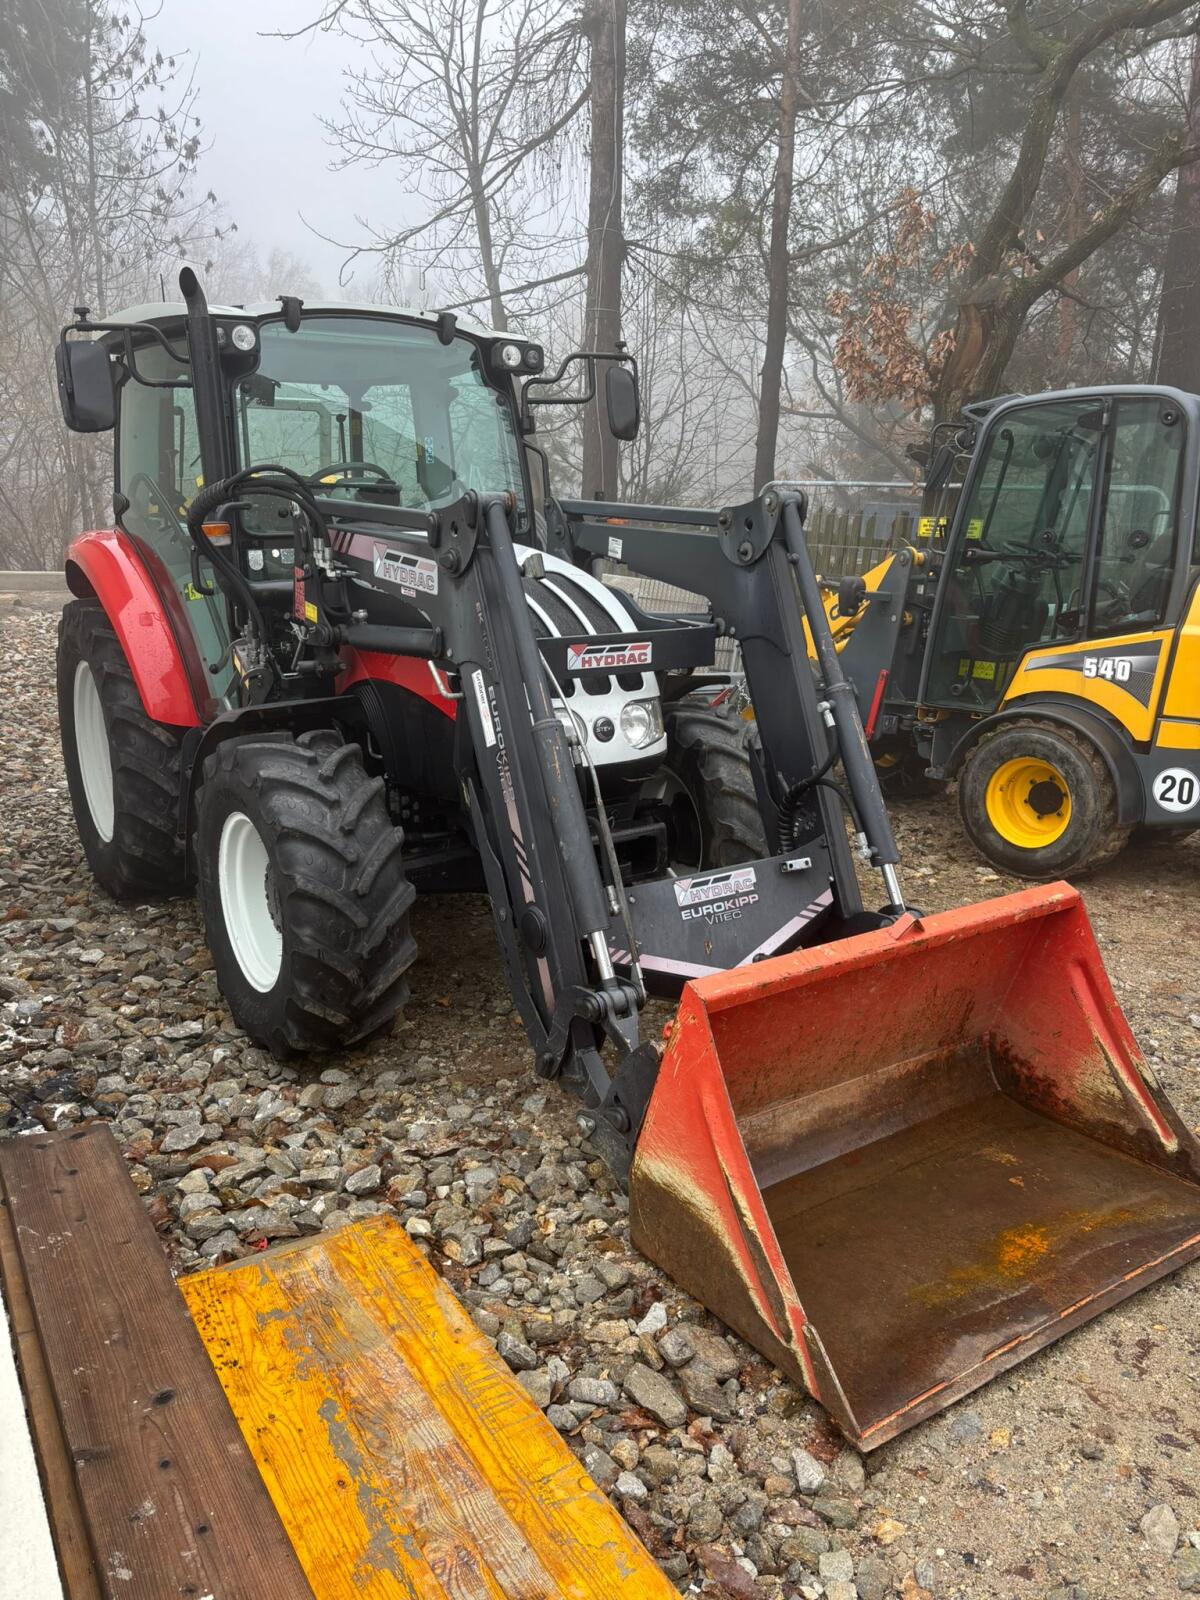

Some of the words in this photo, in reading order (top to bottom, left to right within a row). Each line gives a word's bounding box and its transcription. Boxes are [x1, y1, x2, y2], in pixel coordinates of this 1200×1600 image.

[383, 562, 435, 591] HYDRAC
[581, 652, 648, 668] HYDRAC
[1083, 656, 1132, 682] 540
[1159, 774, 1194, 805] 20
[689, 878, 753, 902] HYDRAC
[681, 893, 759, 921] EUROKIPP
